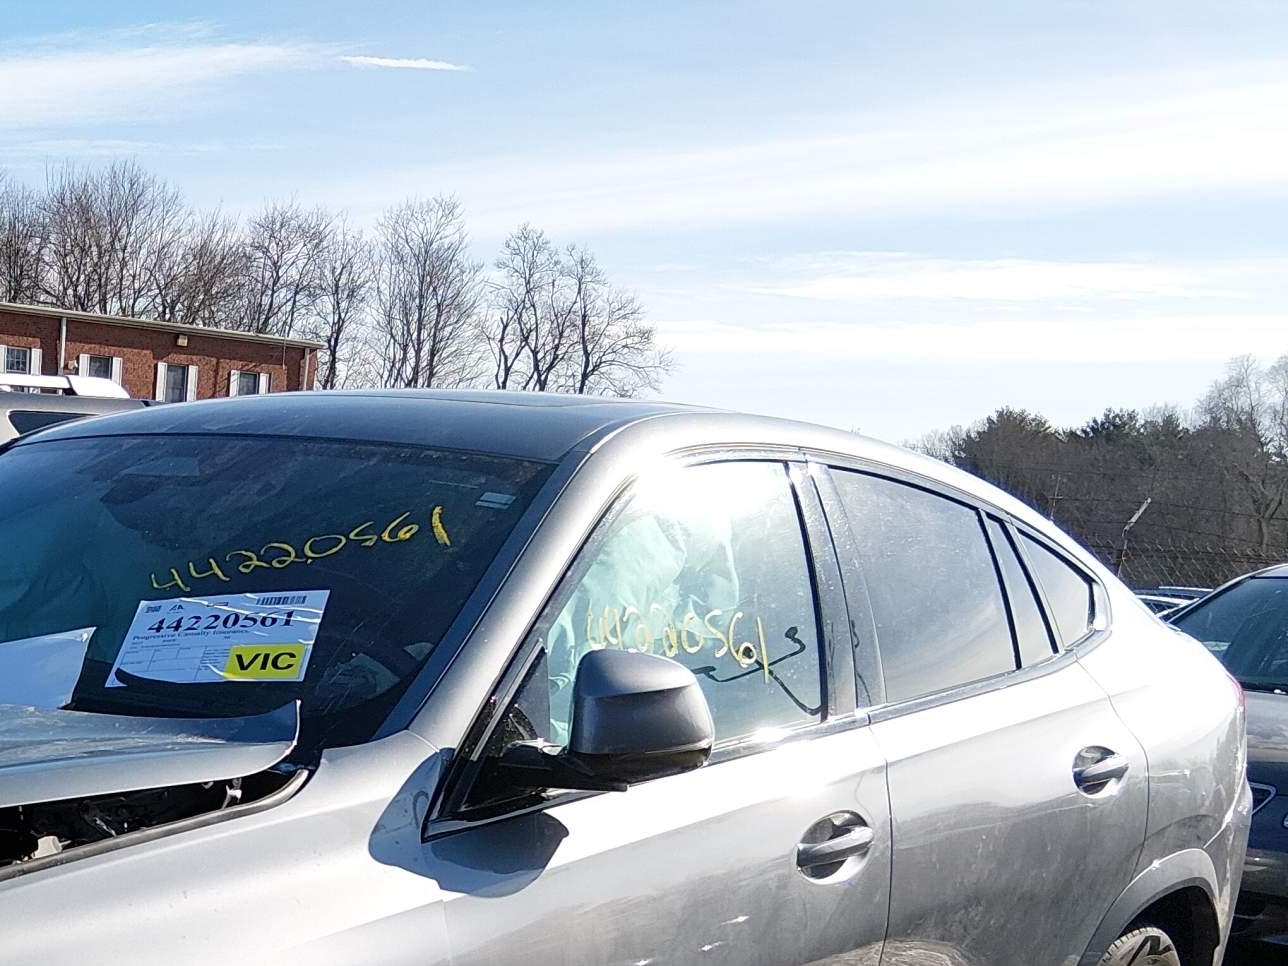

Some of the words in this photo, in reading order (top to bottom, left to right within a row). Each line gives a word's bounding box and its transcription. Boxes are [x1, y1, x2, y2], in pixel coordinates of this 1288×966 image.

[150, 505, 452, 592] 44220561
[147, 610, 295, 634] 44220561
[234, 651, 297, 672] VIC
